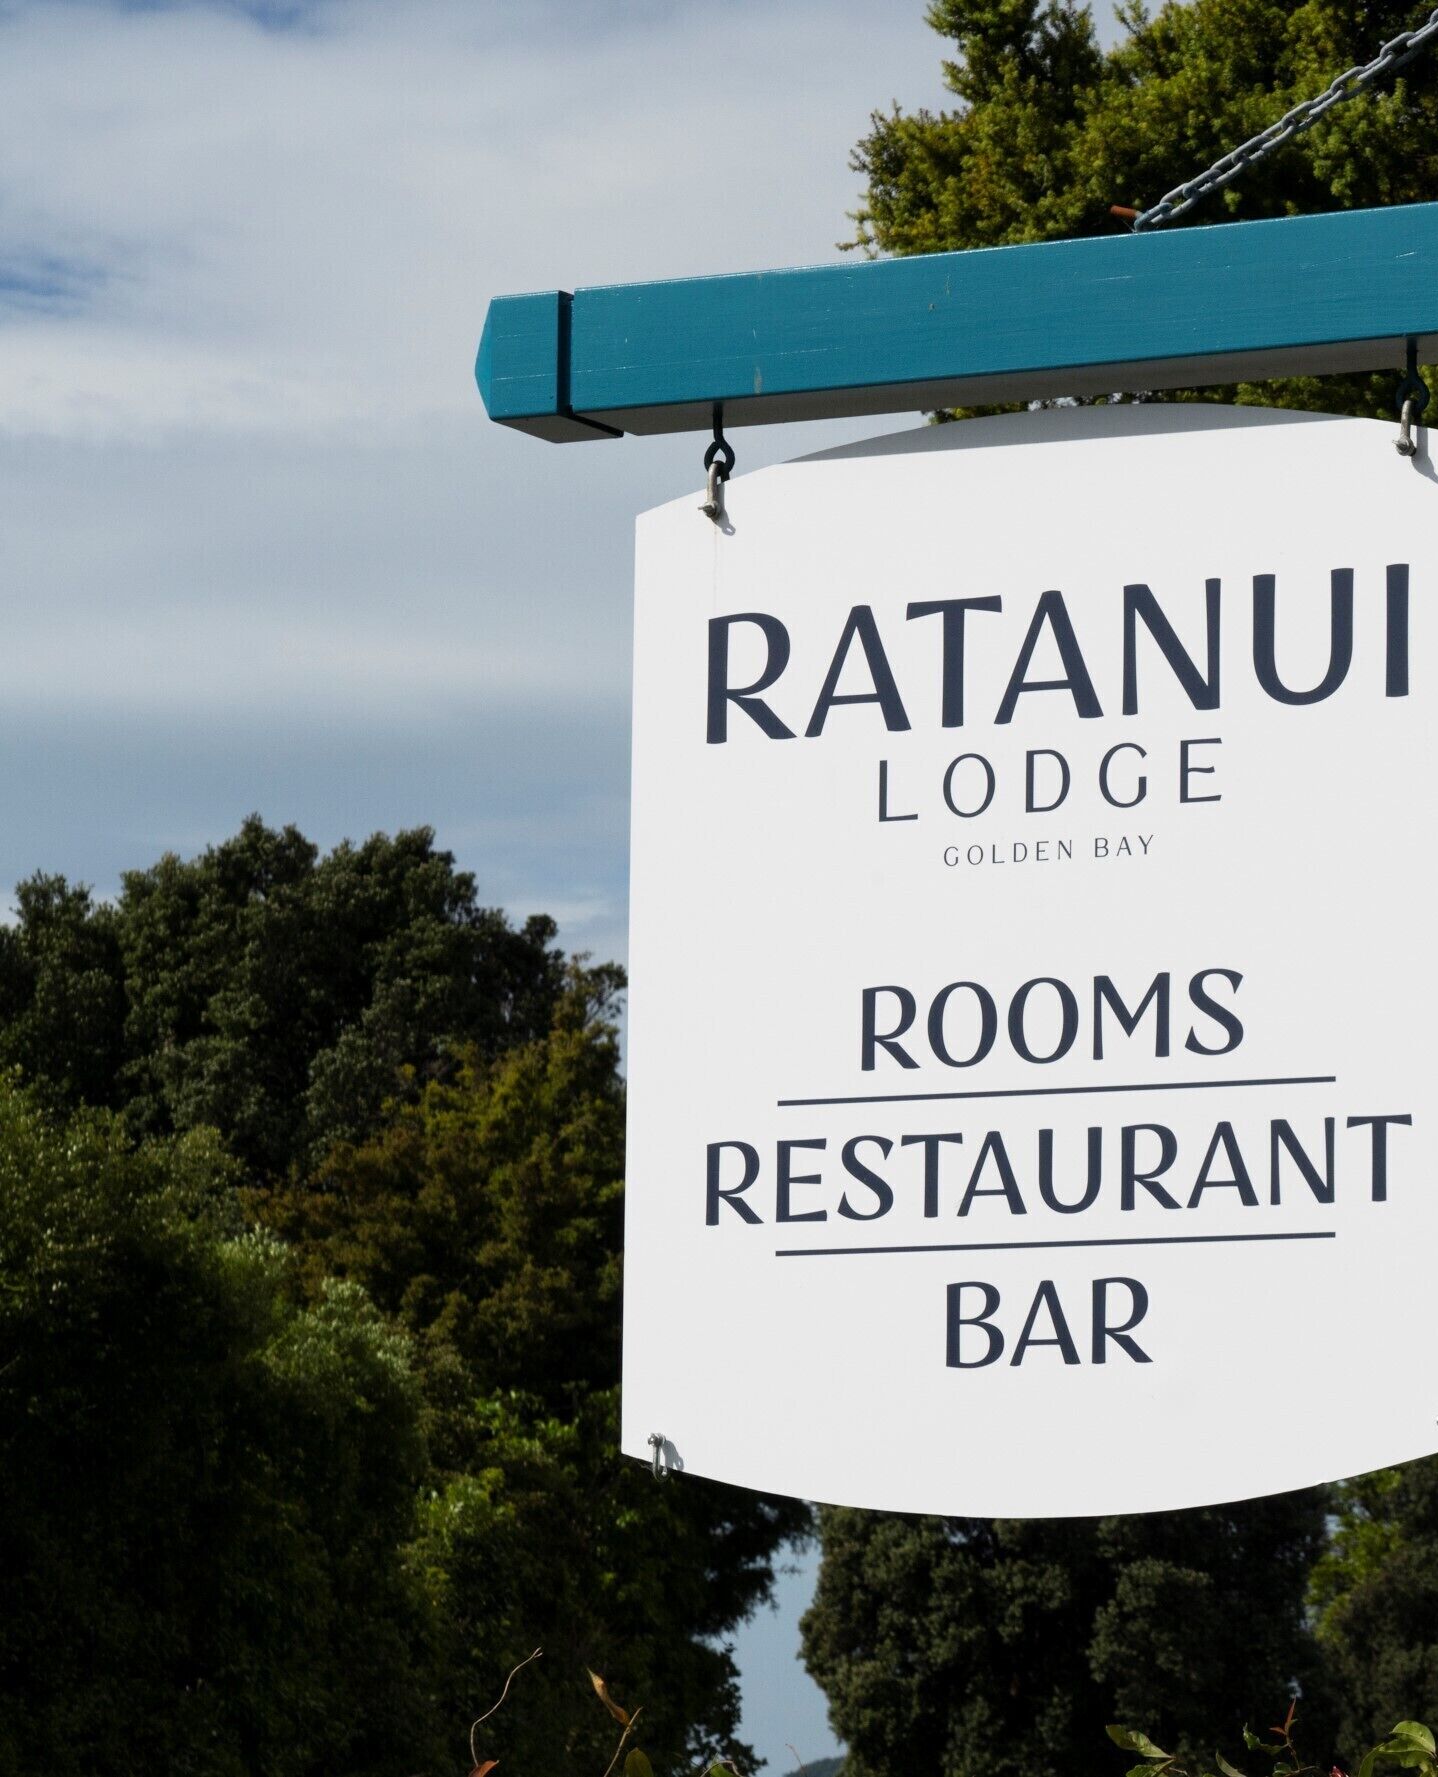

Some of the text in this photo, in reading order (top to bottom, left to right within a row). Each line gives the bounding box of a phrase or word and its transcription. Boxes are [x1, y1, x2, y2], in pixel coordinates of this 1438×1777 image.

[706, 563, 1410, 745] RATANUI
[878, 737, 1223, 823] LODGE
[943, 834, 1155, 867] GOLDEN BAY
[861, 968, 1244, 1072] ROOMS
[705, 1113, 1413, 1227] RESTAURANT
[945, 1276, 1154, 1369] BAR
